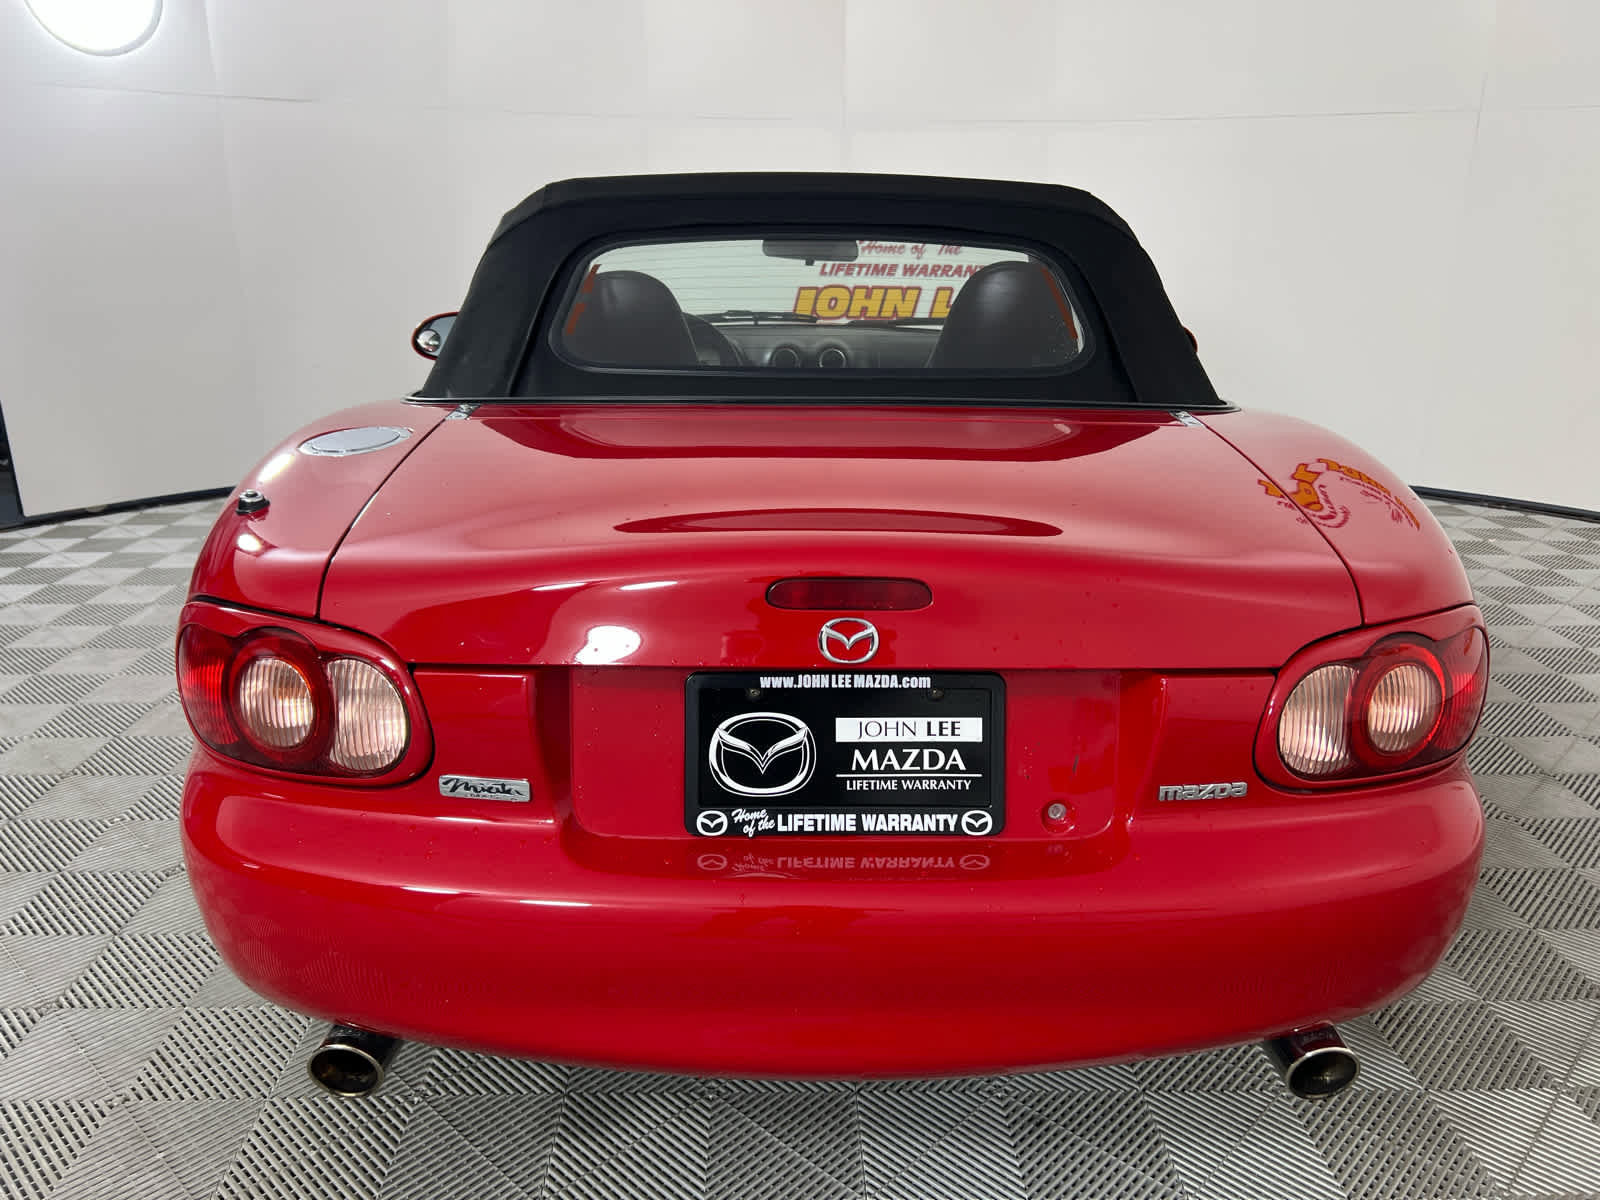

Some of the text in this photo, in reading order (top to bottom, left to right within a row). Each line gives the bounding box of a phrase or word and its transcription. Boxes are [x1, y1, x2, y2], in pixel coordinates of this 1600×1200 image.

[819, 263, 984, 278] LIFETIME WARRAN
[793, 284, 922, 320] JOHN
[858, 721, 961, 739] JOHN LEE
[851, 748, 967, 771] MAZDA
[846, 779, 972, 791] LIFETIME WARRANTY
[731, 808, 767, 823] Home
[777, 813, 958, 832] LIFETIME WARRANTY
[743, 815, 775, 838] of the
